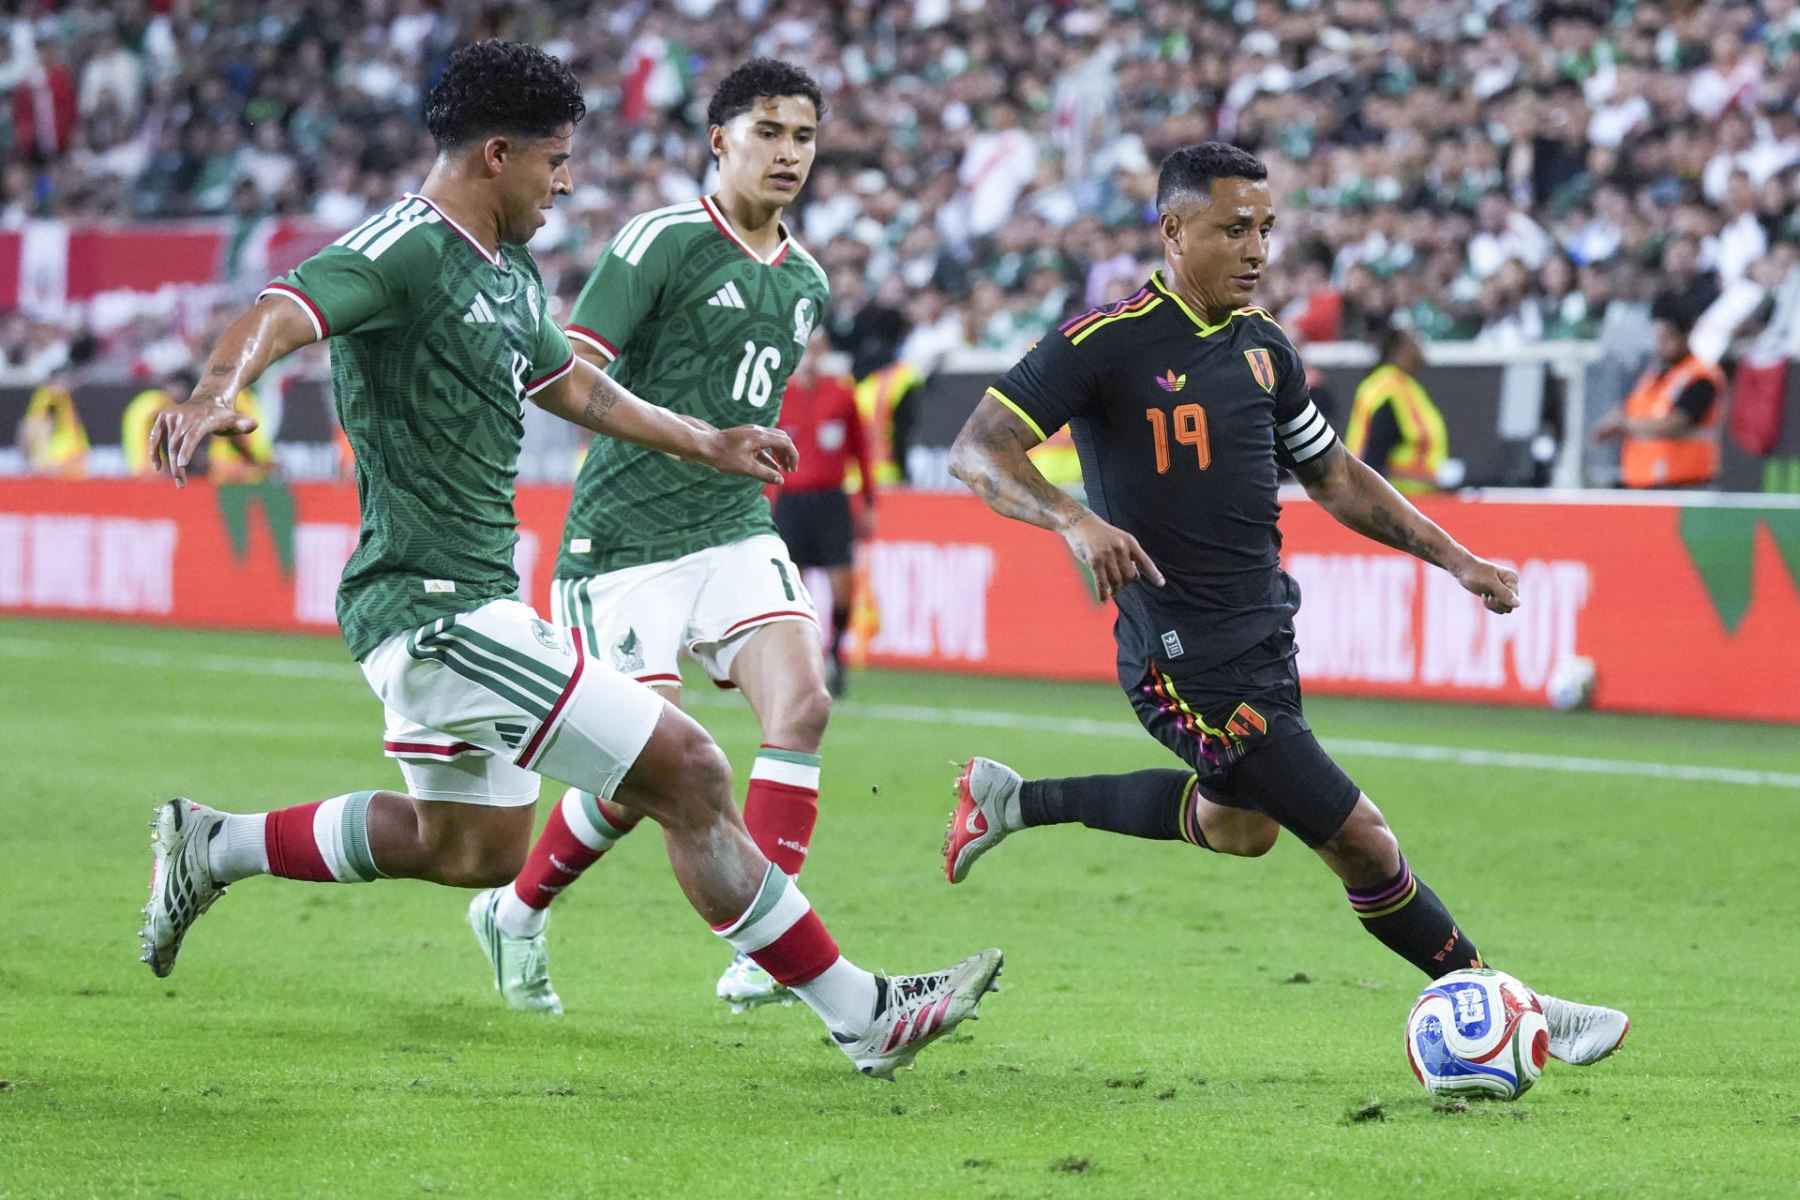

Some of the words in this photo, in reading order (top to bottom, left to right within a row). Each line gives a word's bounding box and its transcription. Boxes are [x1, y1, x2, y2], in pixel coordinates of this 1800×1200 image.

[731, 340, 781, 408] 16
[1146, 403, 1212, 475] 19
[1433, 925, 1459, 962] FPF
